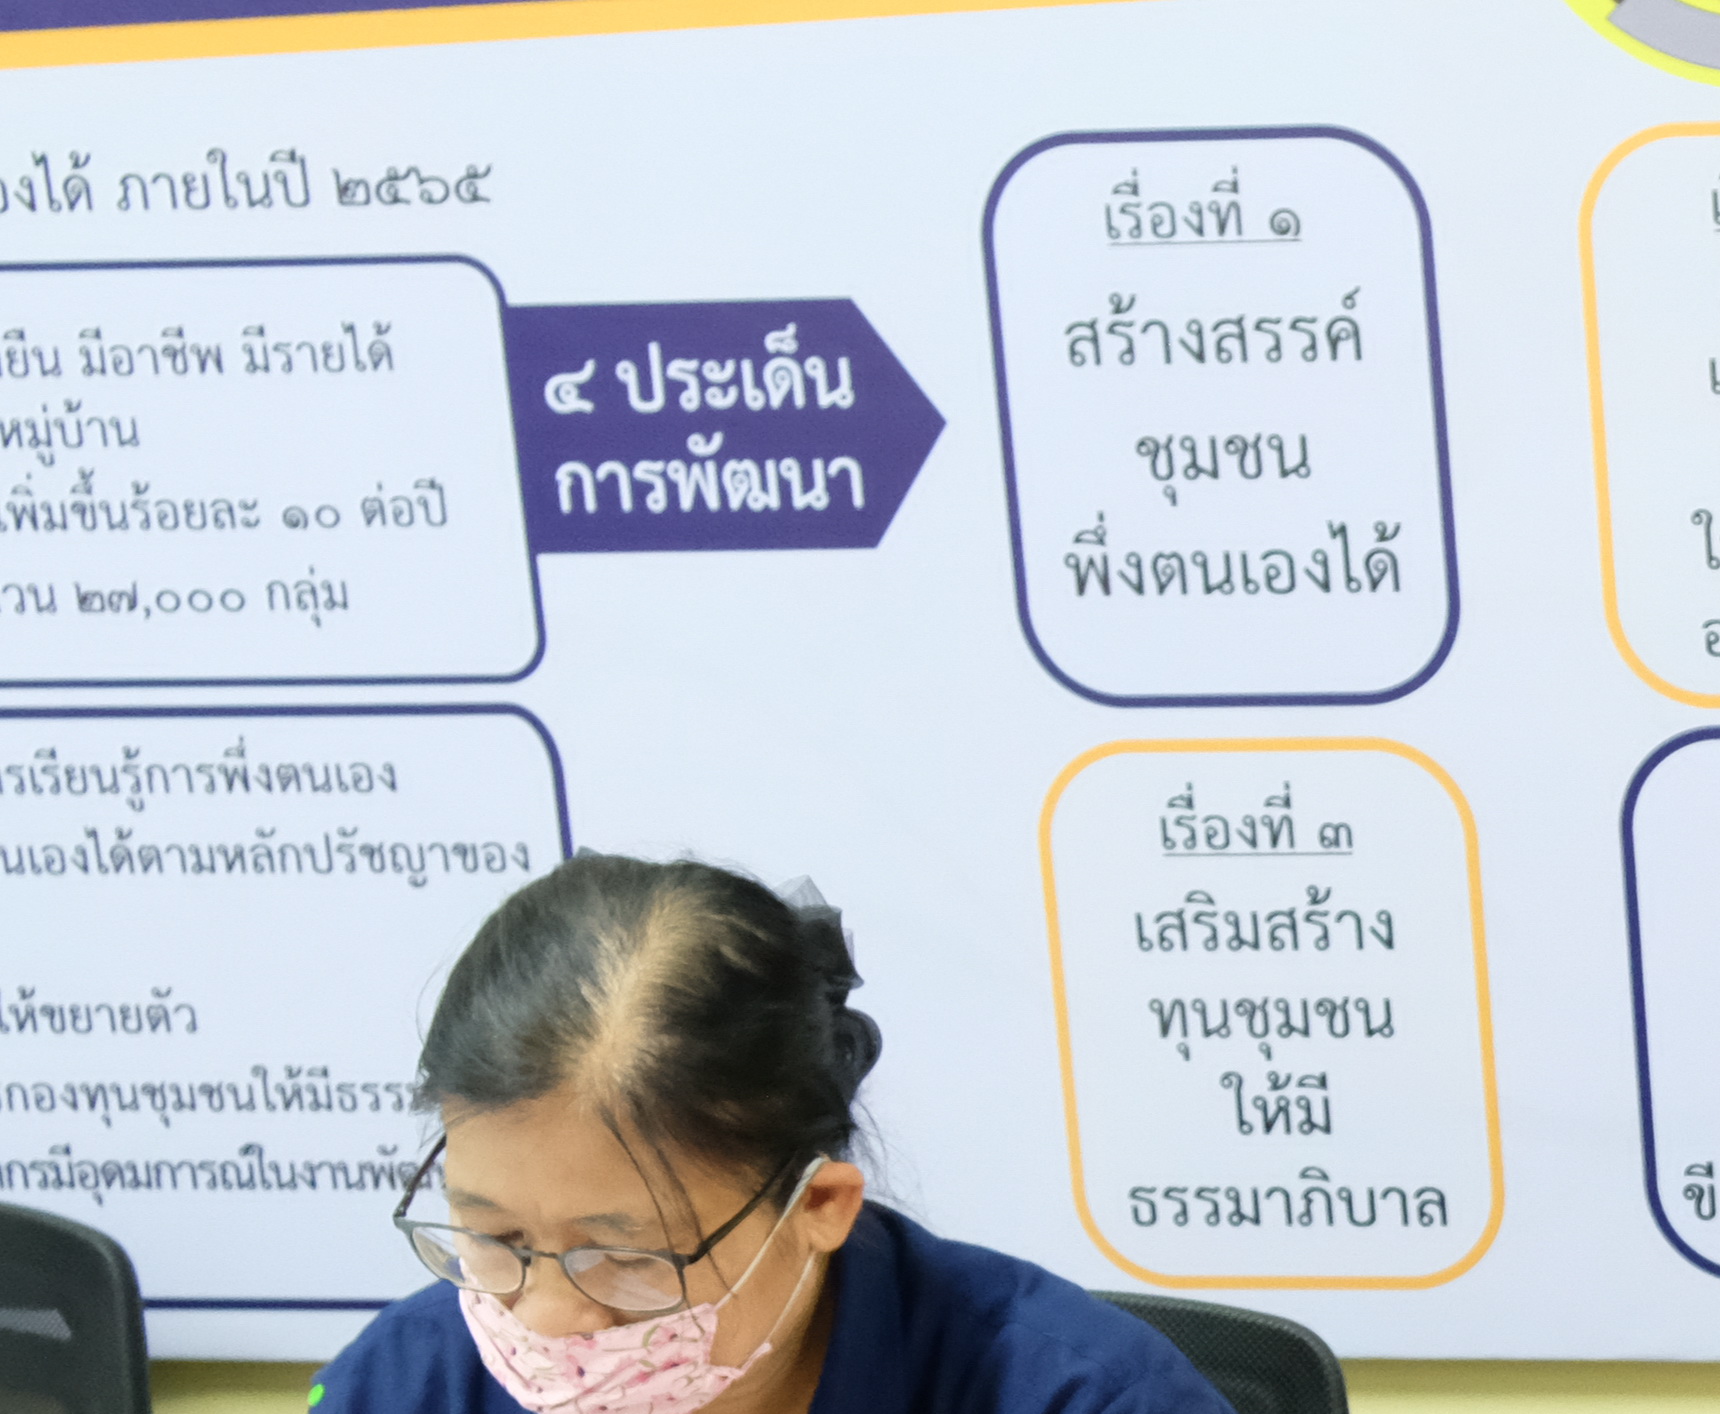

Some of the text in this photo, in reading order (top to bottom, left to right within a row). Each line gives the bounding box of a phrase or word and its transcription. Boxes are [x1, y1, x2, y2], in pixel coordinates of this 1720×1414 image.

[0, 148, 491, 213] งได้ ภายในปี ๒๕๖๕
[1104, 166, 1302, 240] เรื่องที่ ๑
[0, 322, 393, 378] ยืน มีอาชีพ มีรายได้
[1065, 288, 1362, 367] สร้างสรรค์
[541, 323, 854, 416] ๔ ประเด็น
[555, 432, 864, 513] การพัฒนา
[1136, 434, 1311, 506] ชุมชน
[282, 505, 341, 529] ๑๐
[361, 478, 447, 527] ต่อปี
[1065, 512, 1400, 596] พึ่งตนเองได้
[266, 566, 349, 628] กลุ่ม
[0, 736, 397, 812] รเรียนรู้การพึ่งตนเอง
[1160, 781, 1353, 851] เรื่องที่ ๓
[1136, 885, 1394, 951] เสริมสร้าง
[1149, 997, 1394, 1061] ทุนชุมชน
[0, 1063, 418, 1128] กองทุนชุมชนให้มีธรร
[1221, 1072, 1331, 1135] ให้มี
[1129, 1167, 1448, 1227] ธรรมาภิบาล
